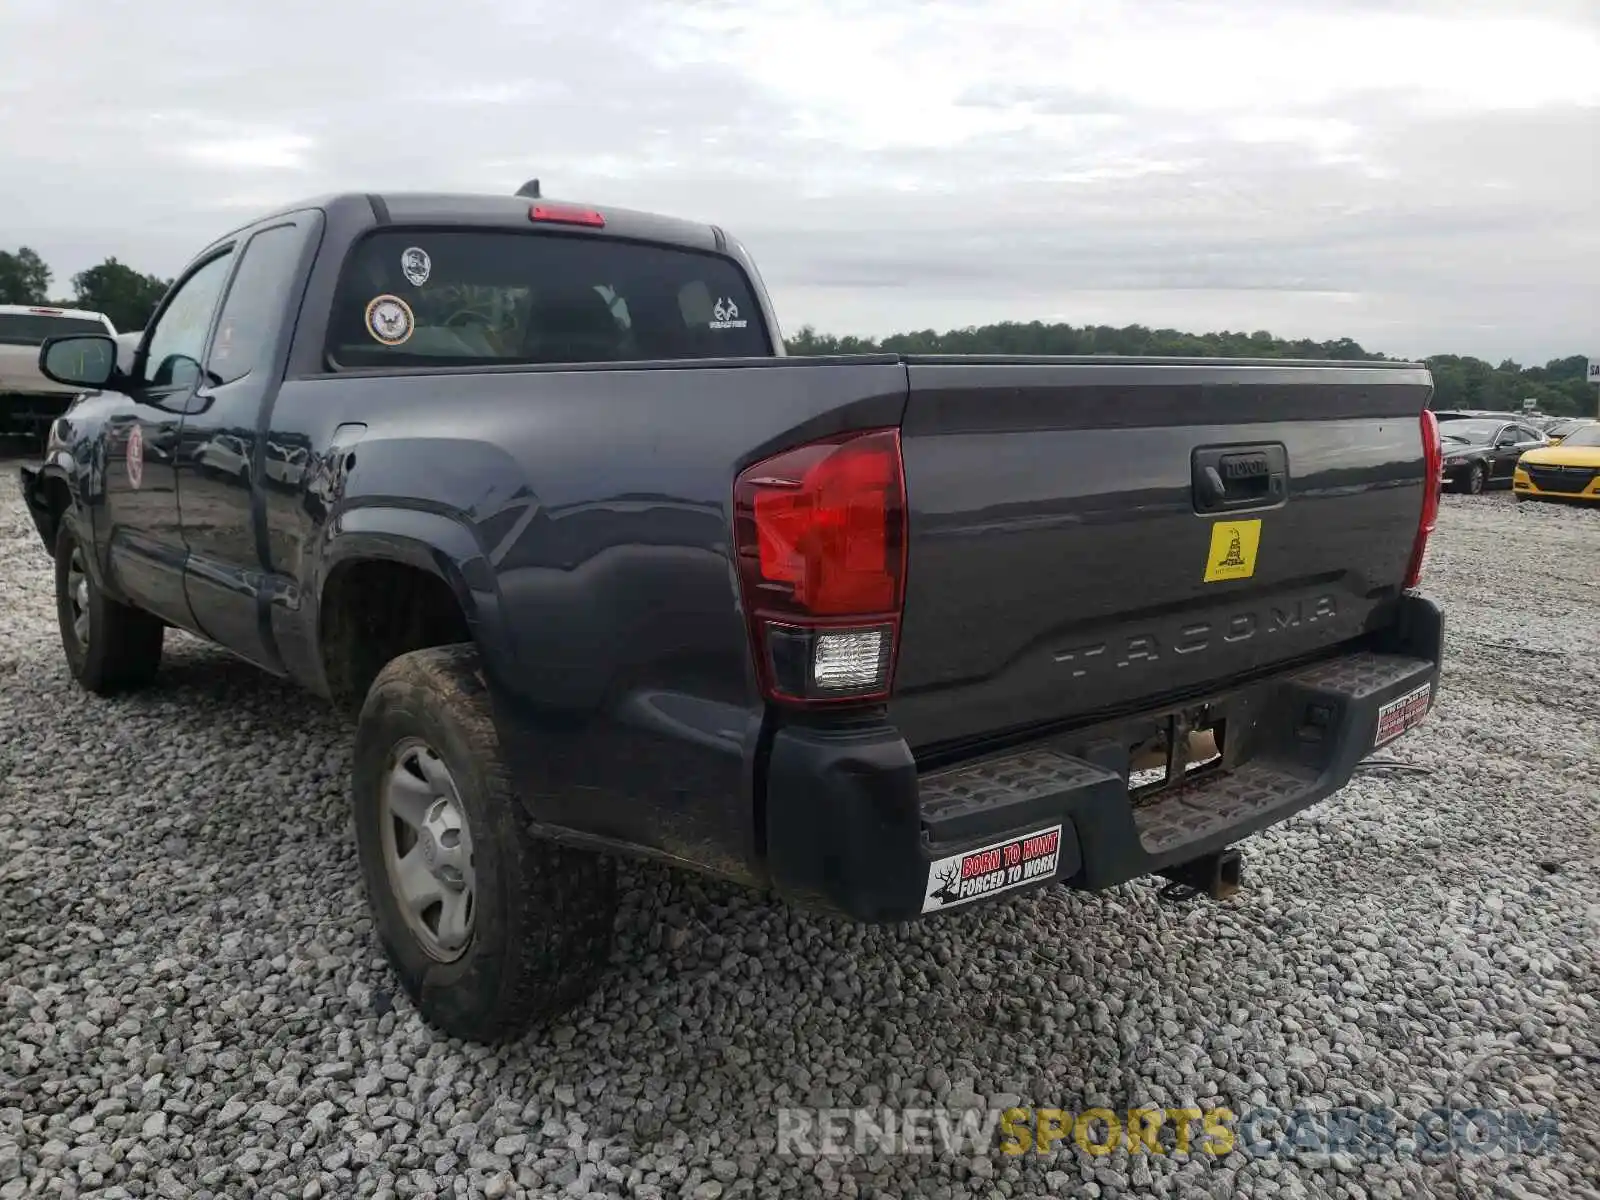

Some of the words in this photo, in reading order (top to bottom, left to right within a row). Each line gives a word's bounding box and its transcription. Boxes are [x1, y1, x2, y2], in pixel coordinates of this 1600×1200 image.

[1053, 595, 1337, 677] TACOMA
[960, 869, 1005, 899] FORCED
[1007, 864, 1021, 884] TO
[1024, 854, 1056, 879] WORK
[962, 848, 1000, 879] BORN
[1004, 842, 1021, 867] TO
[1023, 831, 1058, 860] HUNT
